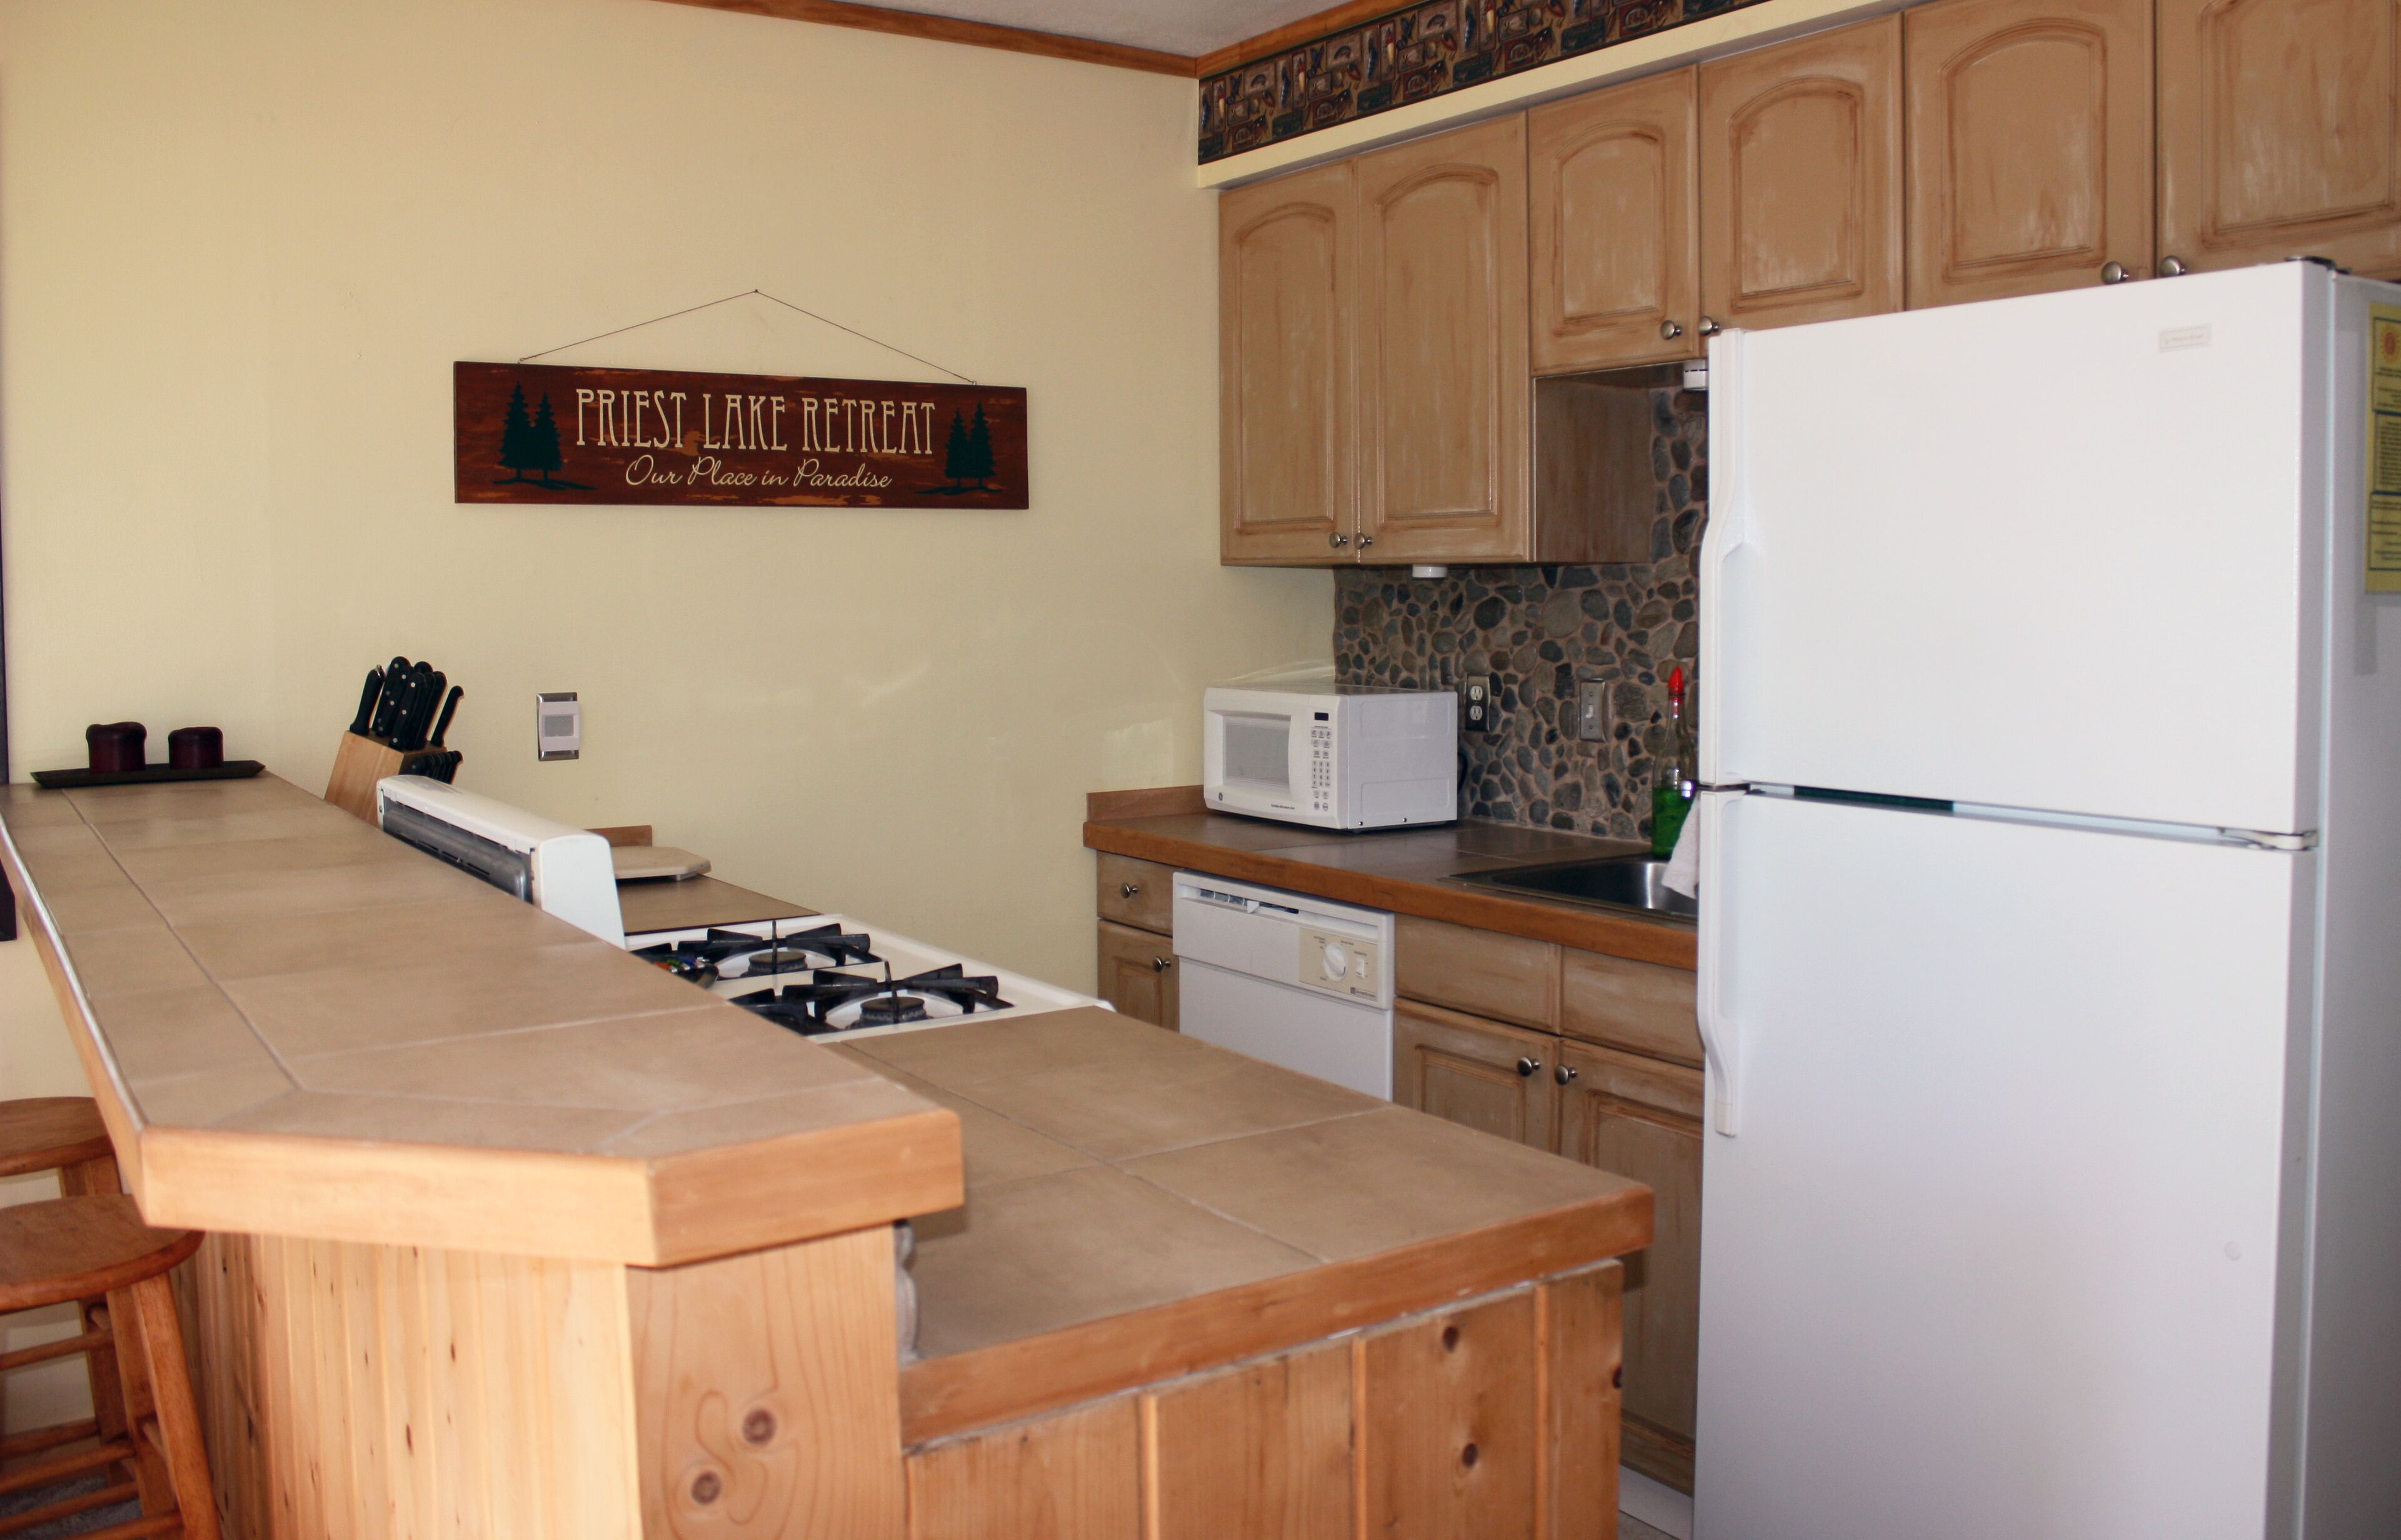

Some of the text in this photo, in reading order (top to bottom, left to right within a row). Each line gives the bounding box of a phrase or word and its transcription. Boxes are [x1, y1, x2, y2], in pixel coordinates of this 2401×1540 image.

[576, 388, 936, 455] PRIEST LAKE RETREAT
[625, 454, 893, 488] Our Place in Paradise
